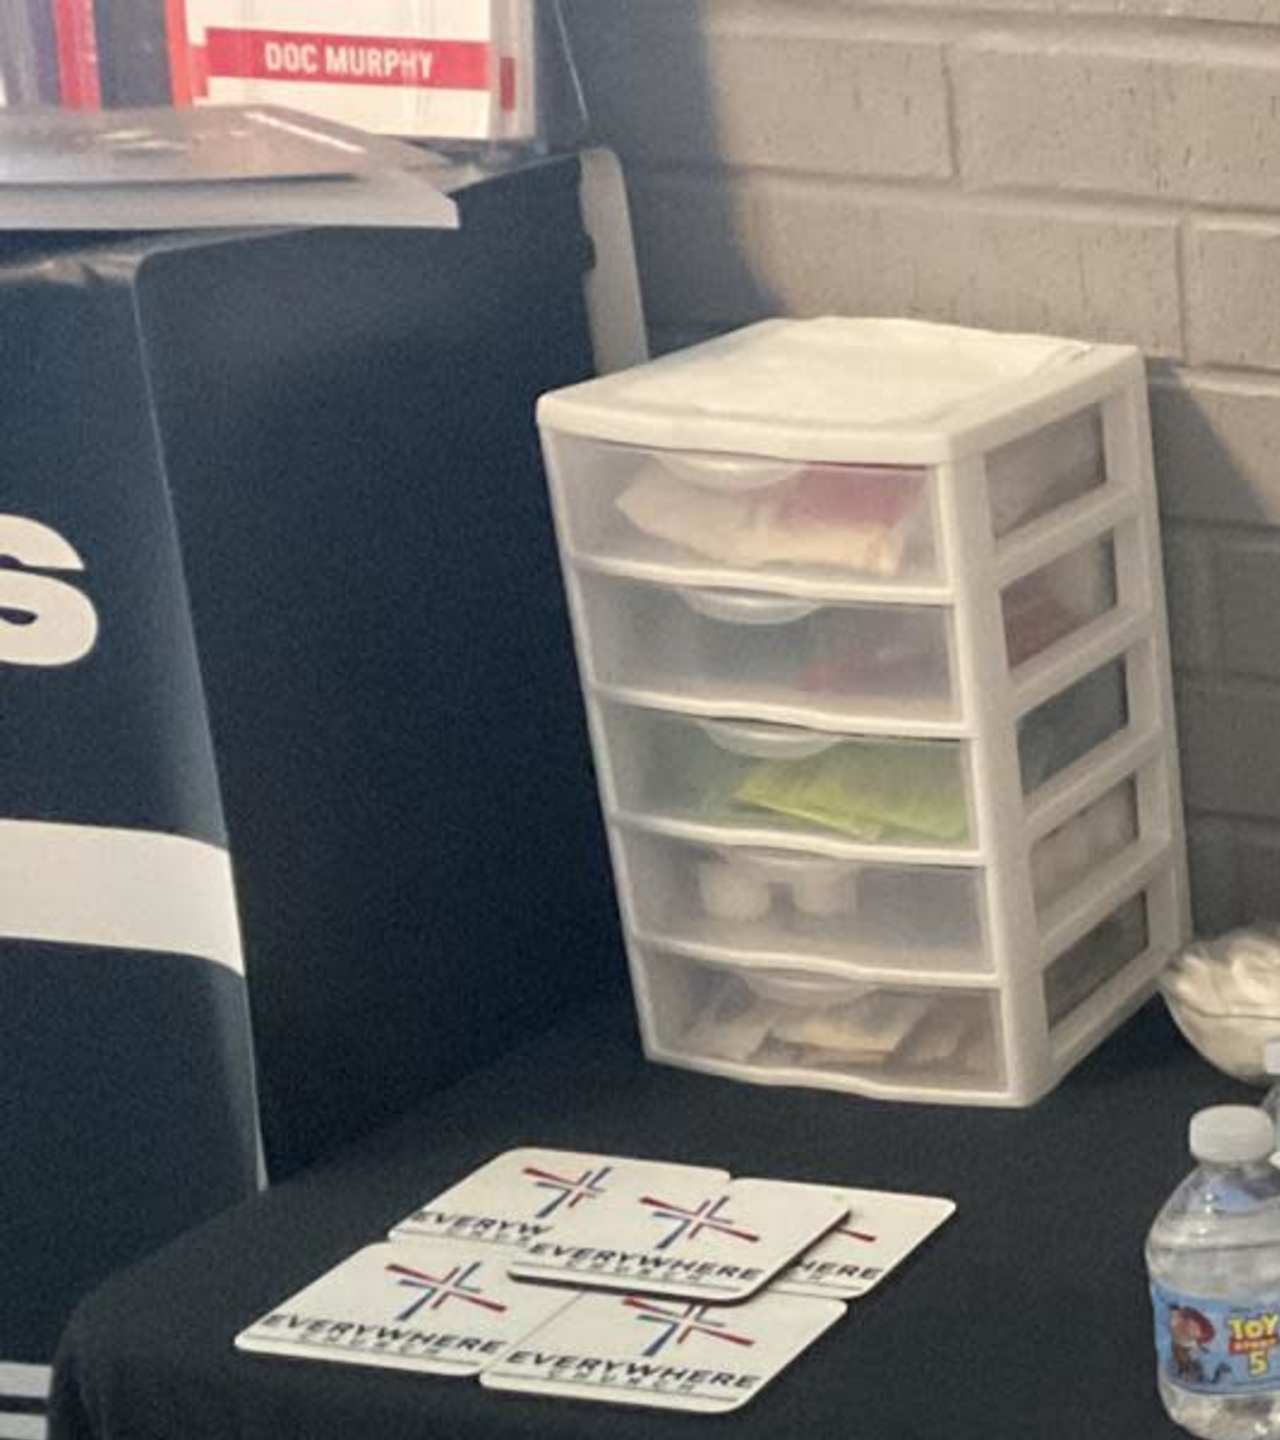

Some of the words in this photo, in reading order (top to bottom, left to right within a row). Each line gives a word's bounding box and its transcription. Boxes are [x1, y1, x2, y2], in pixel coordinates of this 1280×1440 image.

[264, 41, 318, 73] DOC
[325, 44, 434, 80] MURPHY
[528, 1242, 767, 1281] EVERYWHERE
[262, 1314, 508, 1352] EVERYWHERE
[1228, 1314, 1280, 1340] TOY
[506, 1350, 763, 1389] EVERYWHERE
[1250, 1350, 1268, 1376] 5
